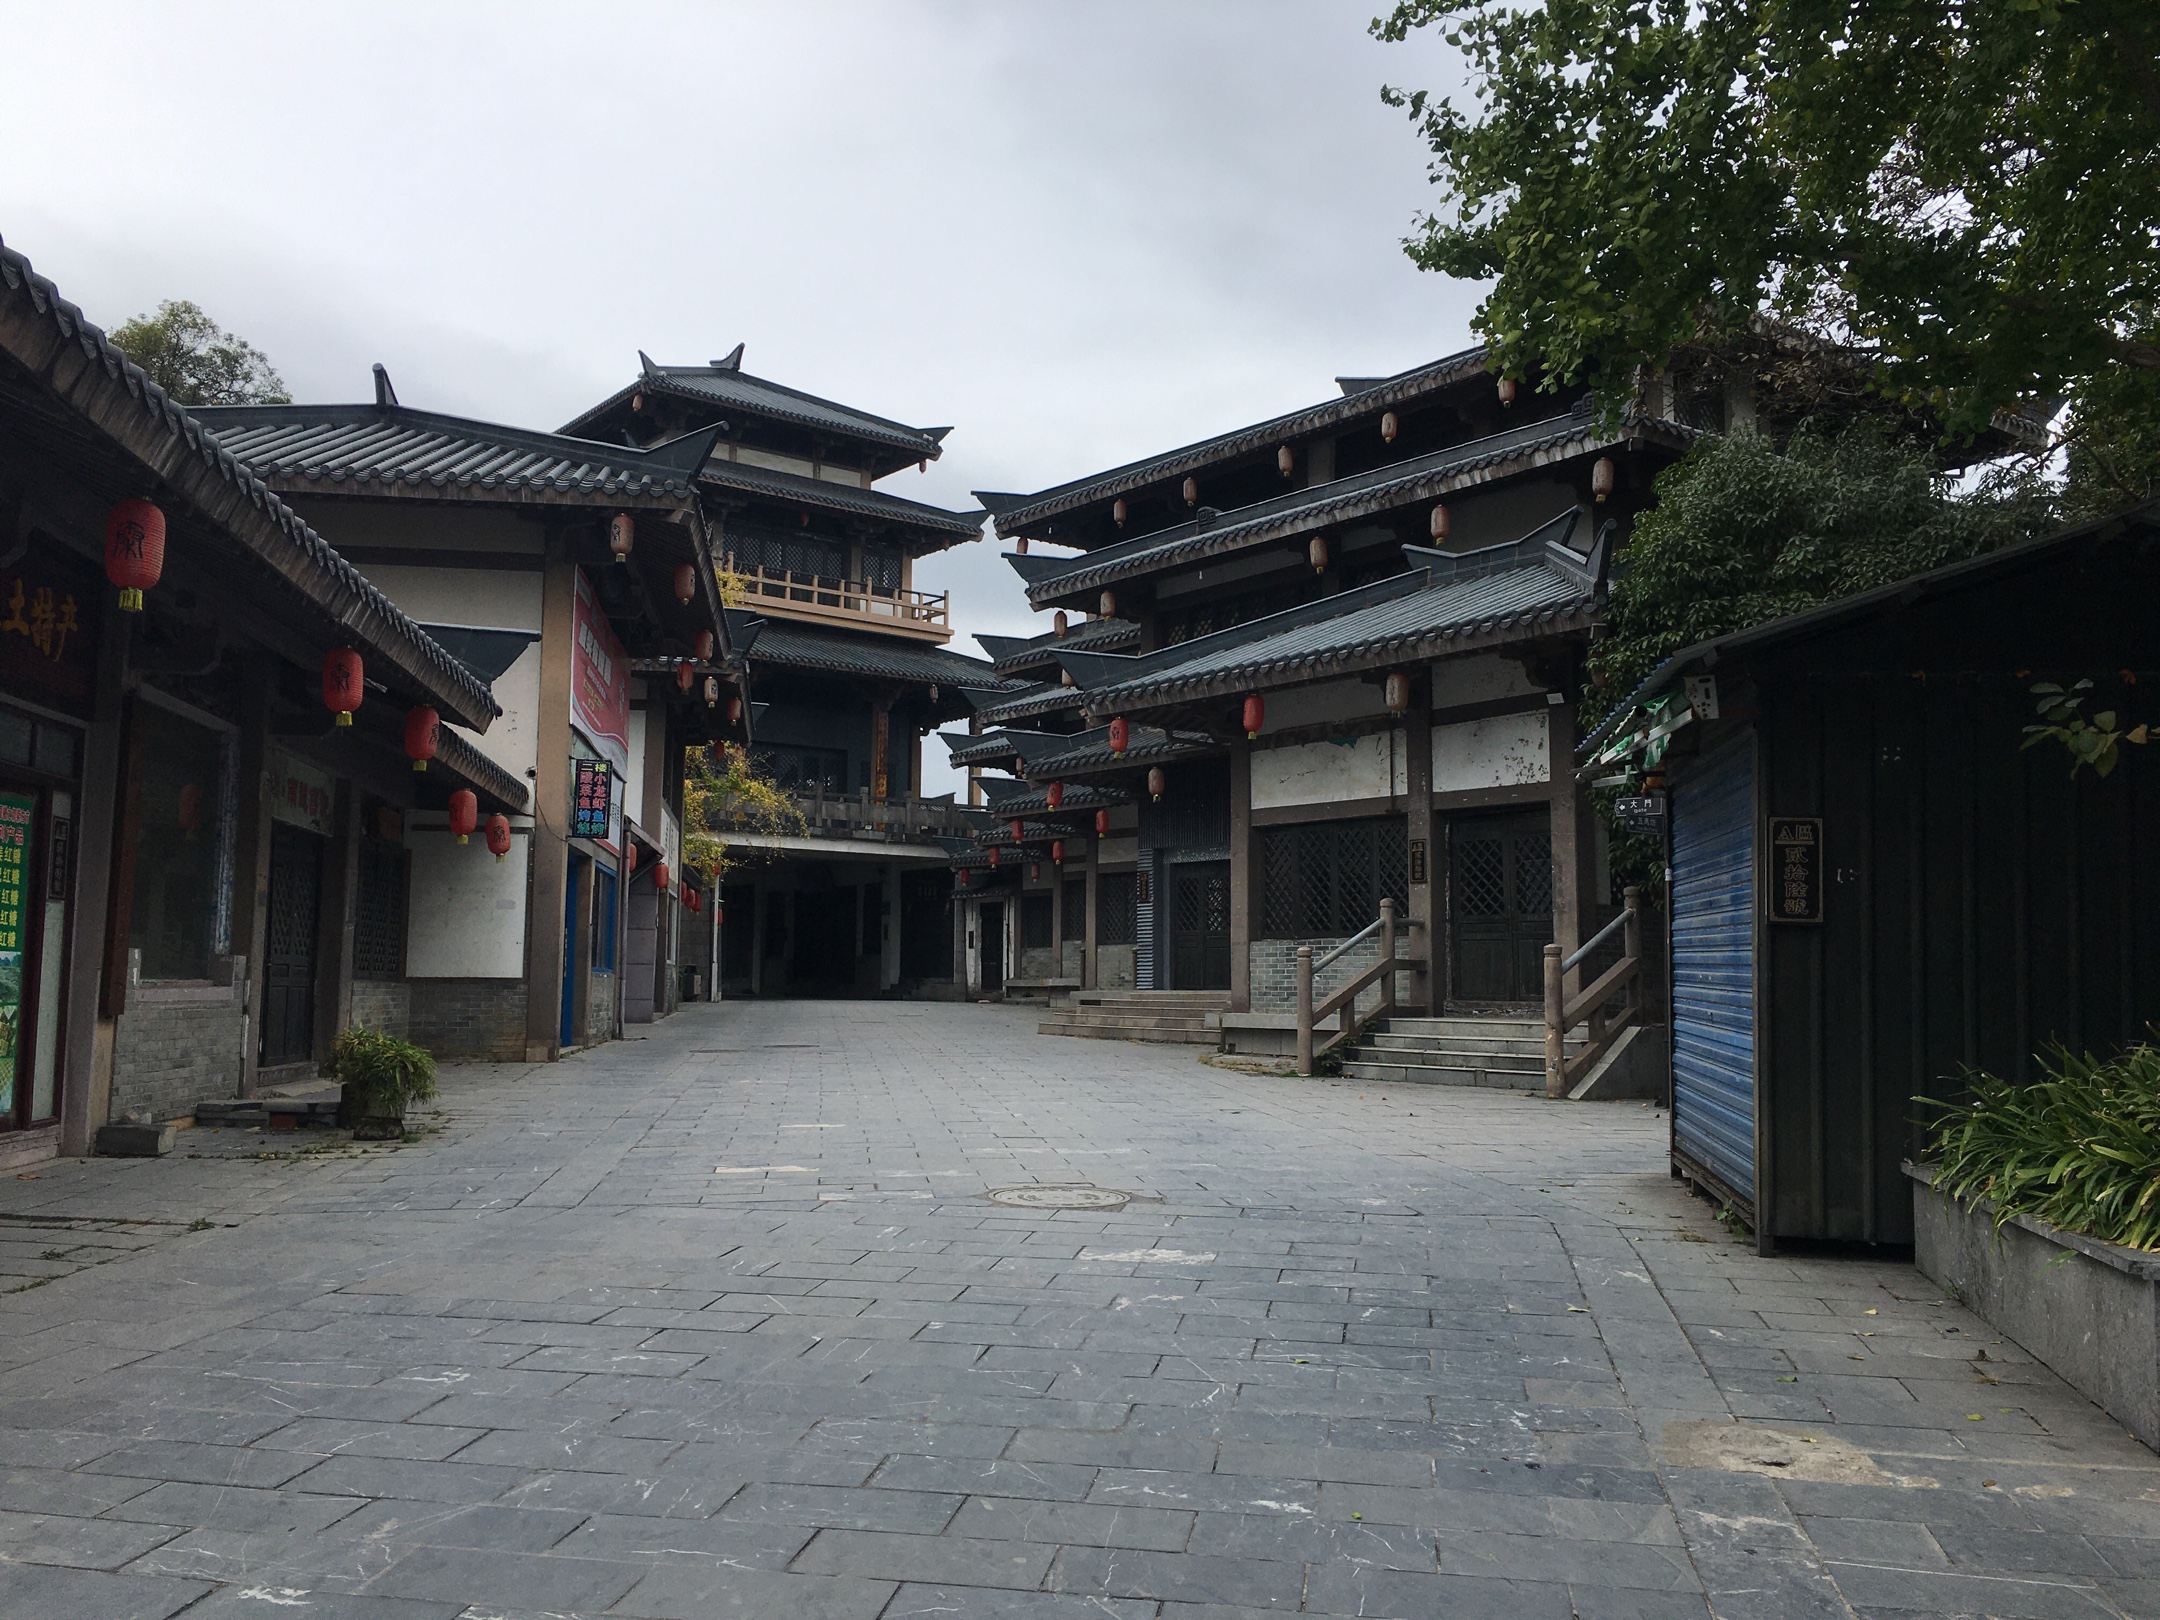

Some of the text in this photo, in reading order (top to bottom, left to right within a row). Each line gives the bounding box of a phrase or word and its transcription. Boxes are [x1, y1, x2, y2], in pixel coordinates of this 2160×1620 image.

[0, 577, 78, 662] 土特产
[579, 771, 594, 809] 酸菜鱼
[592, 773, 607, 810] 小龙虾
[578, 809, 605, 822] 烤鱼
[0, 867, 20, 885] 红糖
